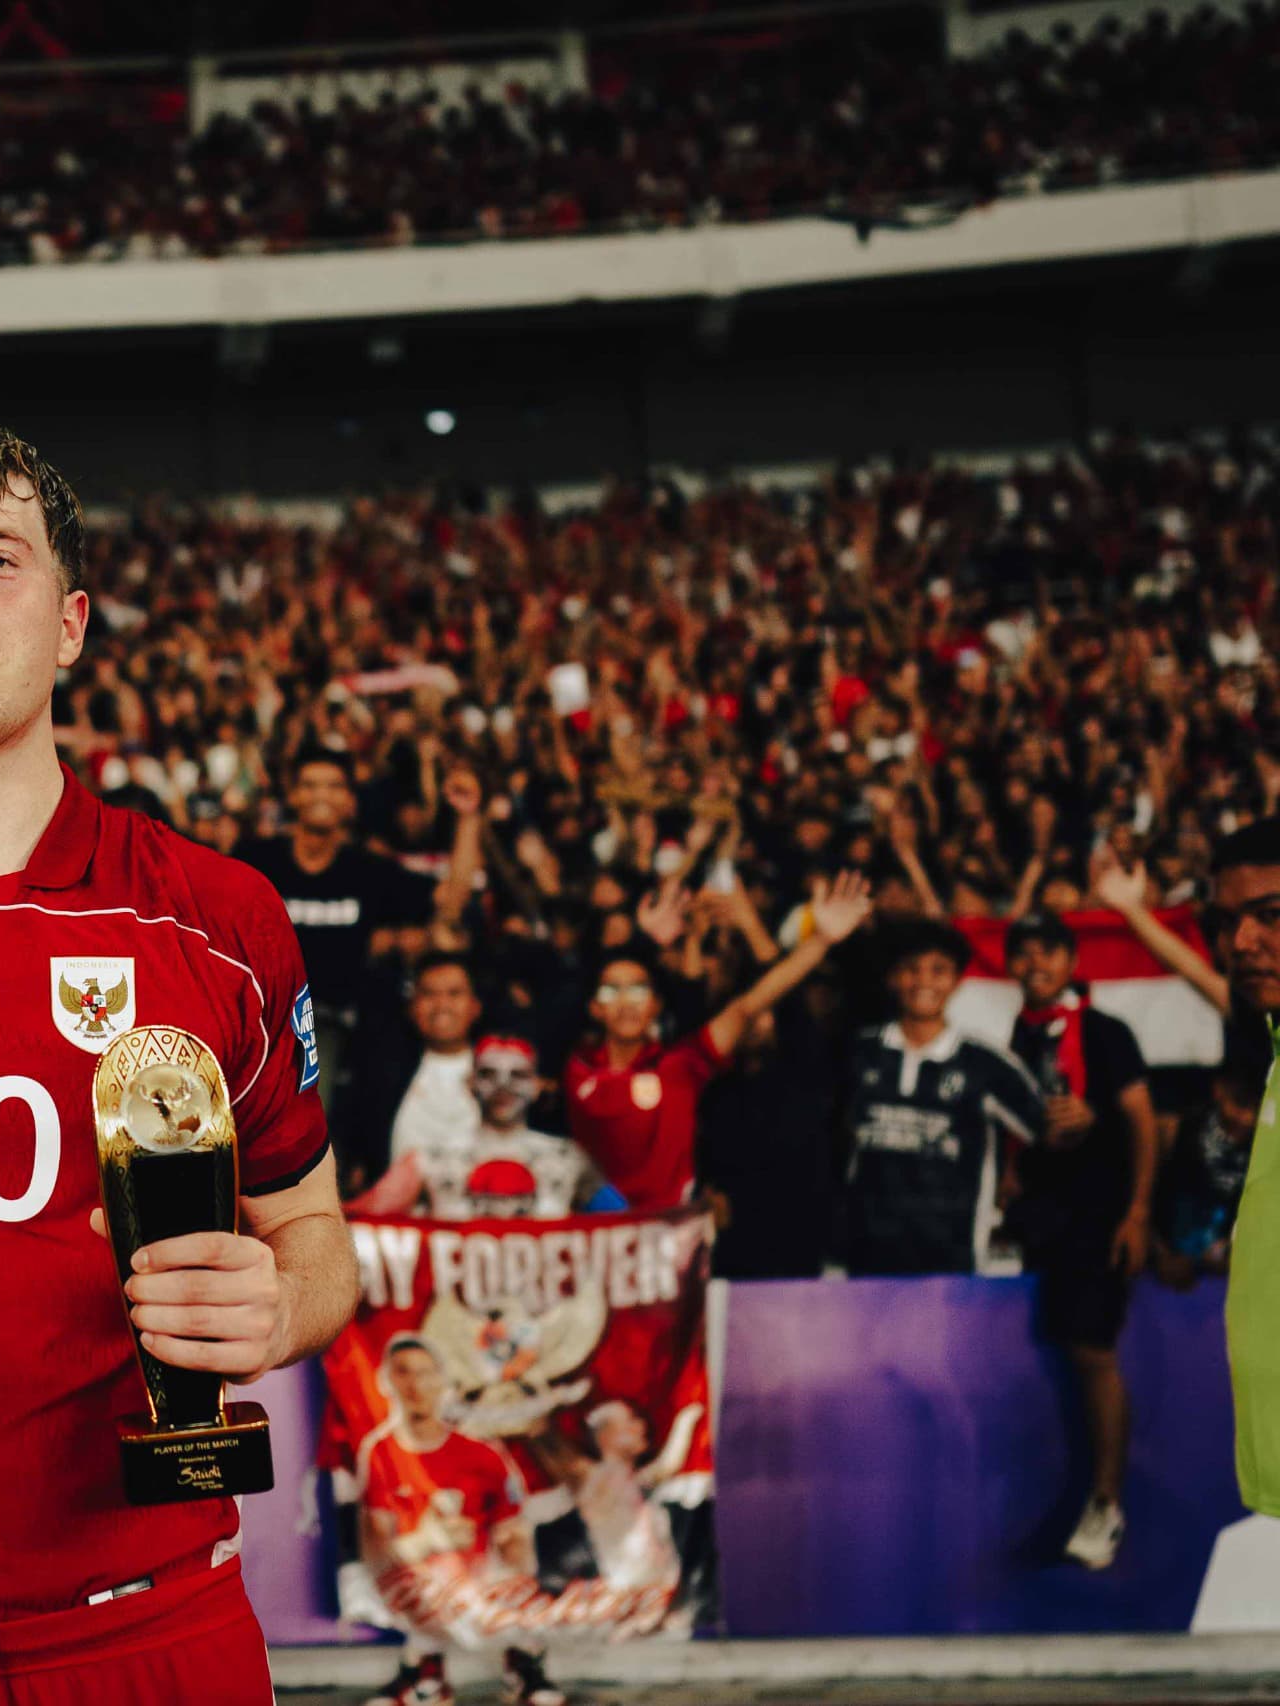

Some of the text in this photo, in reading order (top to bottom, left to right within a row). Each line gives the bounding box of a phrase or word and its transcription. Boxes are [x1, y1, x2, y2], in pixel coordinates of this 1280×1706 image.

[428, 1222, 679, 1311] FOREVER
[154, 1439, 239, 1455] PLAYER OF THE MATCH
